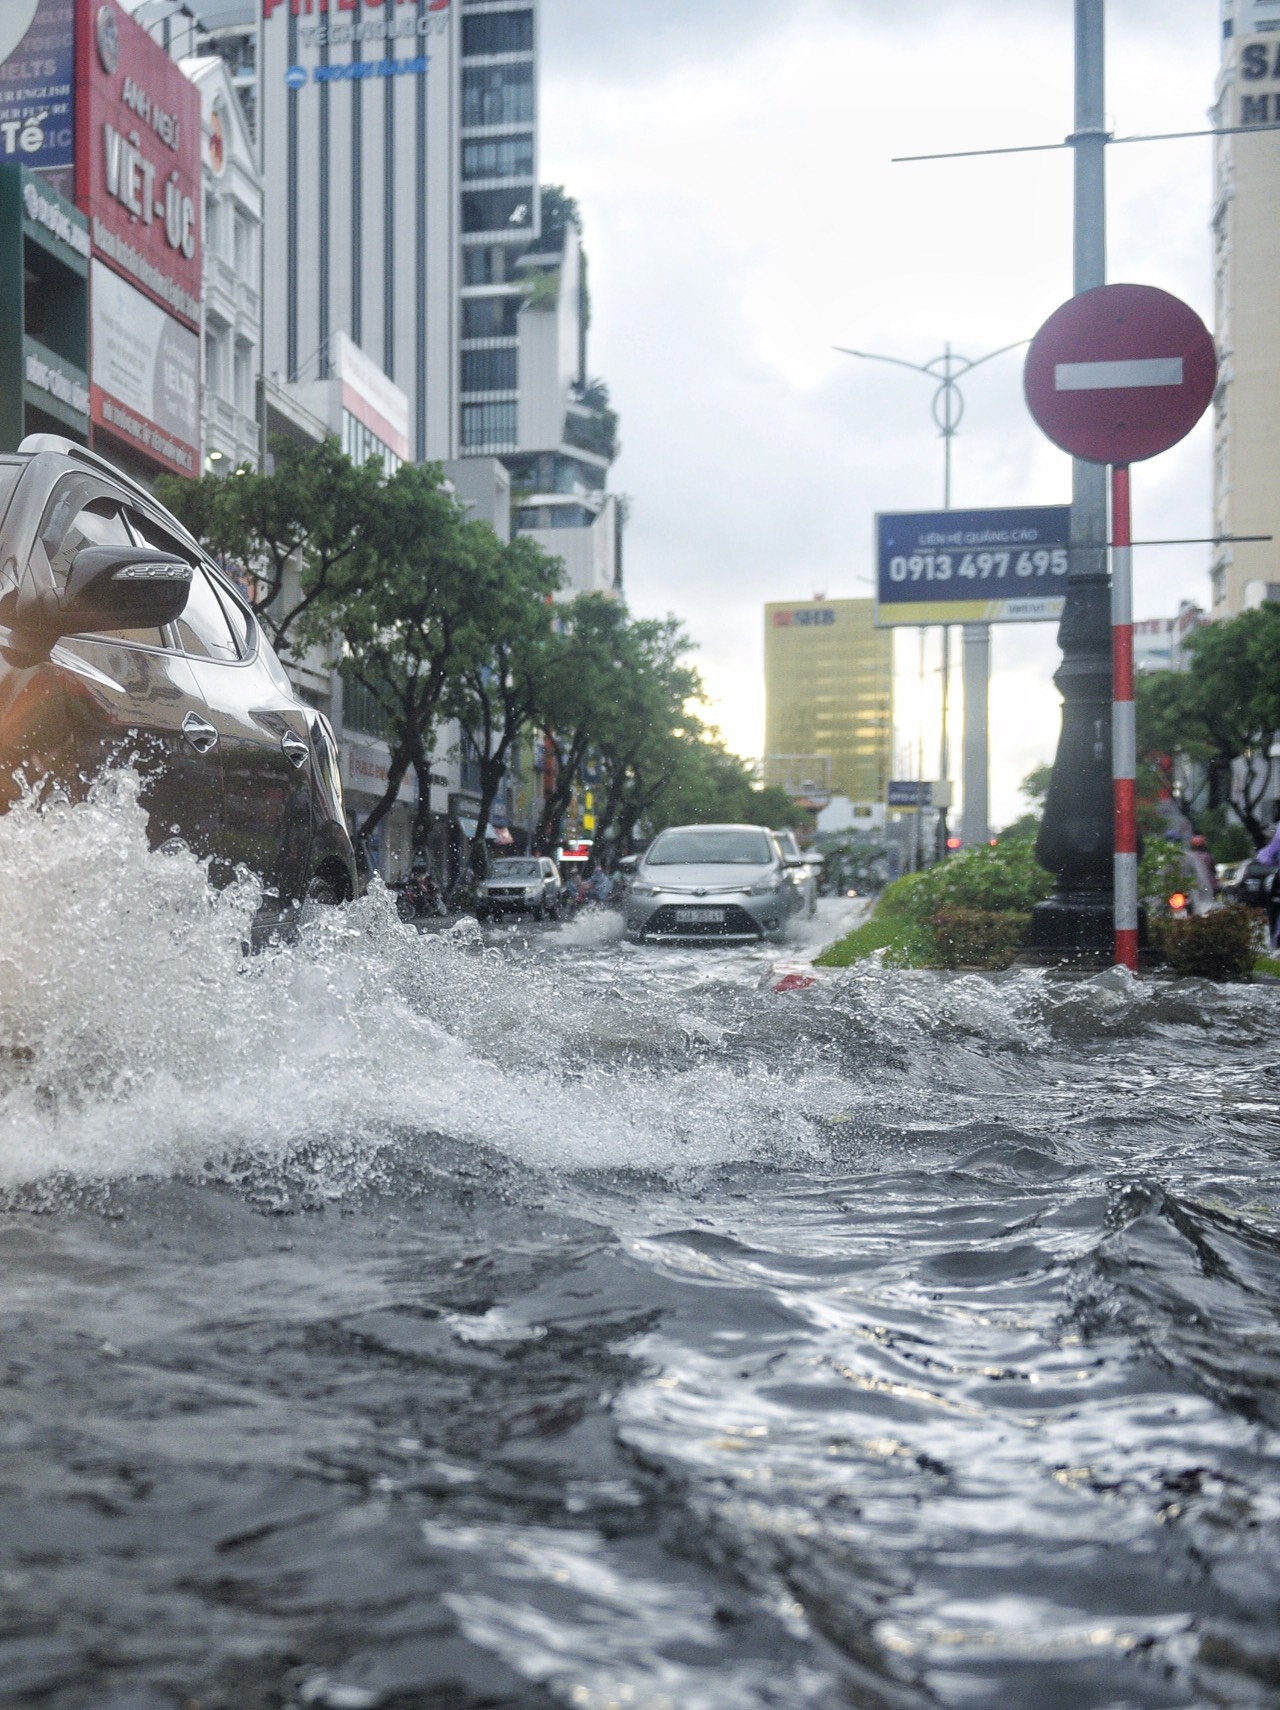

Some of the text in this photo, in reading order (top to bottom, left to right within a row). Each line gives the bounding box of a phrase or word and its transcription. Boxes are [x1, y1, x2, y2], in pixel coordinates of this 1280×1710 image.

[0, 59, 57, 80] IELTS
[1241, 42, 1280, 81] S
[122, 76, 151, 125] ANH
[1240, 94, 1280, 124] M
[0, 110, 48, 154] Tế
[889, 550, 1068, 582] 0913 497 695
